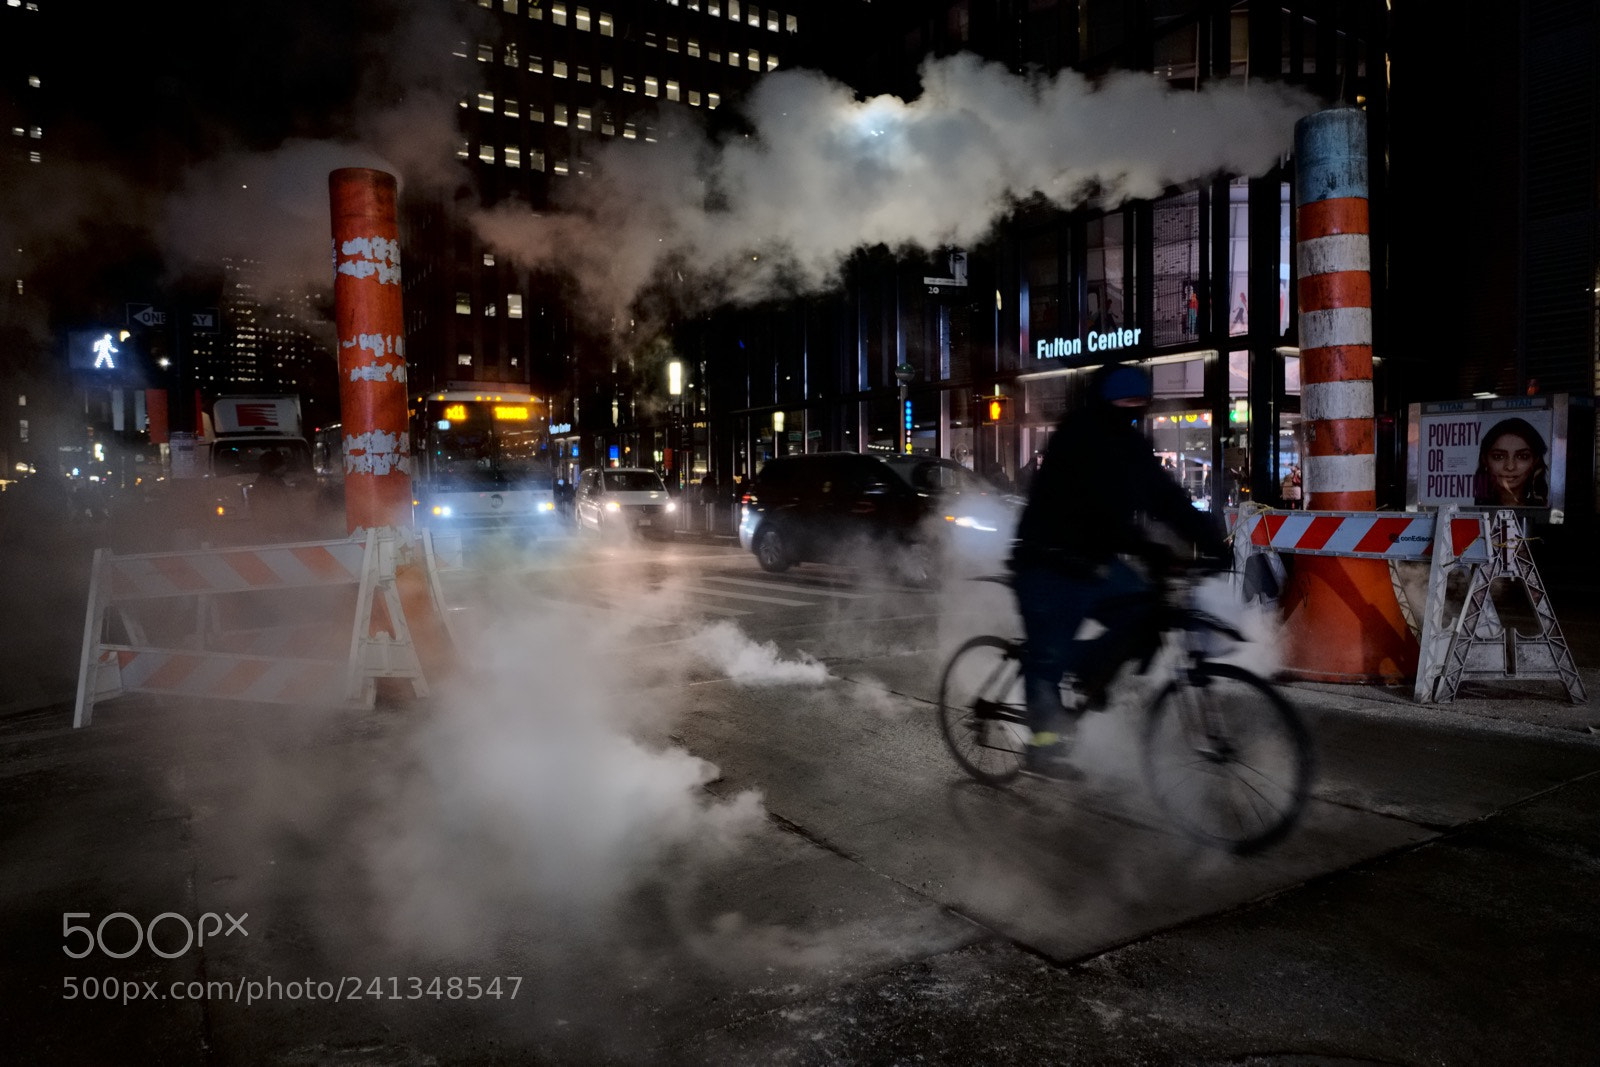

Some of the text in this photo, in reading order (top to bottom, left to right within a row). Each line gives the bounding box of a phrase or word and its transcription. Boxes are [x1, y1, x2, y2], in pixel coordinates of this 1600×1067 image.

[1037, 327, 1141, 360] Fulton Center
[1428, 421, 1482, 447] POVERTY
[1428, 449, 1443, 472] OR
